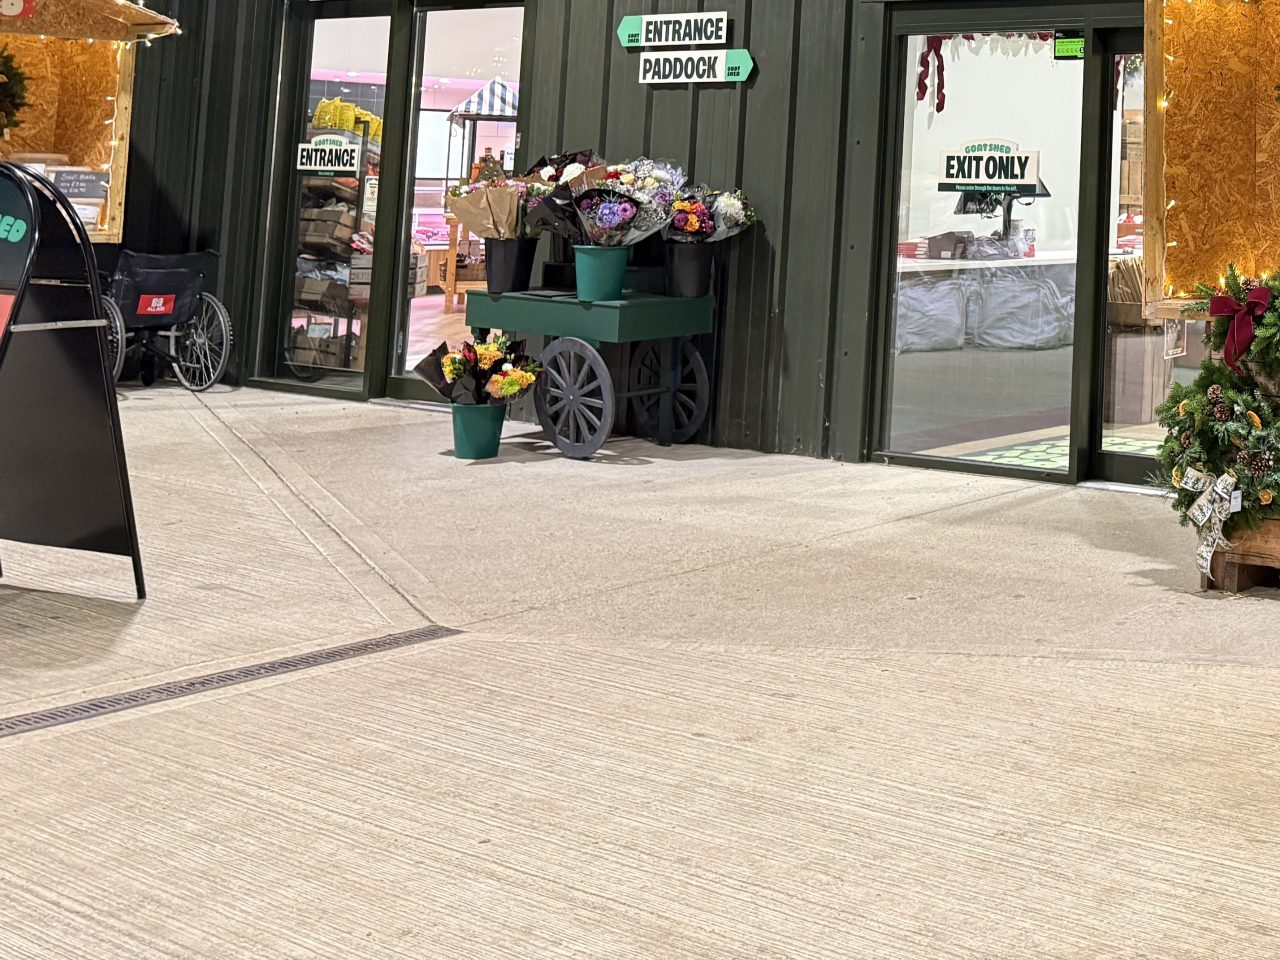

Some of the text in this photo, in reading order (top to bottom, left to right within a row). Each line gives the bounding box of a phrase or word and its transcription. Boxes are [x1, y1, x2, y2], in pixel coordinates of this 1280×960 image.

[645, 17, 724, 43] ENTRANCE
[642, 56, 719, 80] PADDOCK
[299, 147, 356, 168] ENTRANCE
[945, 155, 1030, 180] EXIT ONLY
